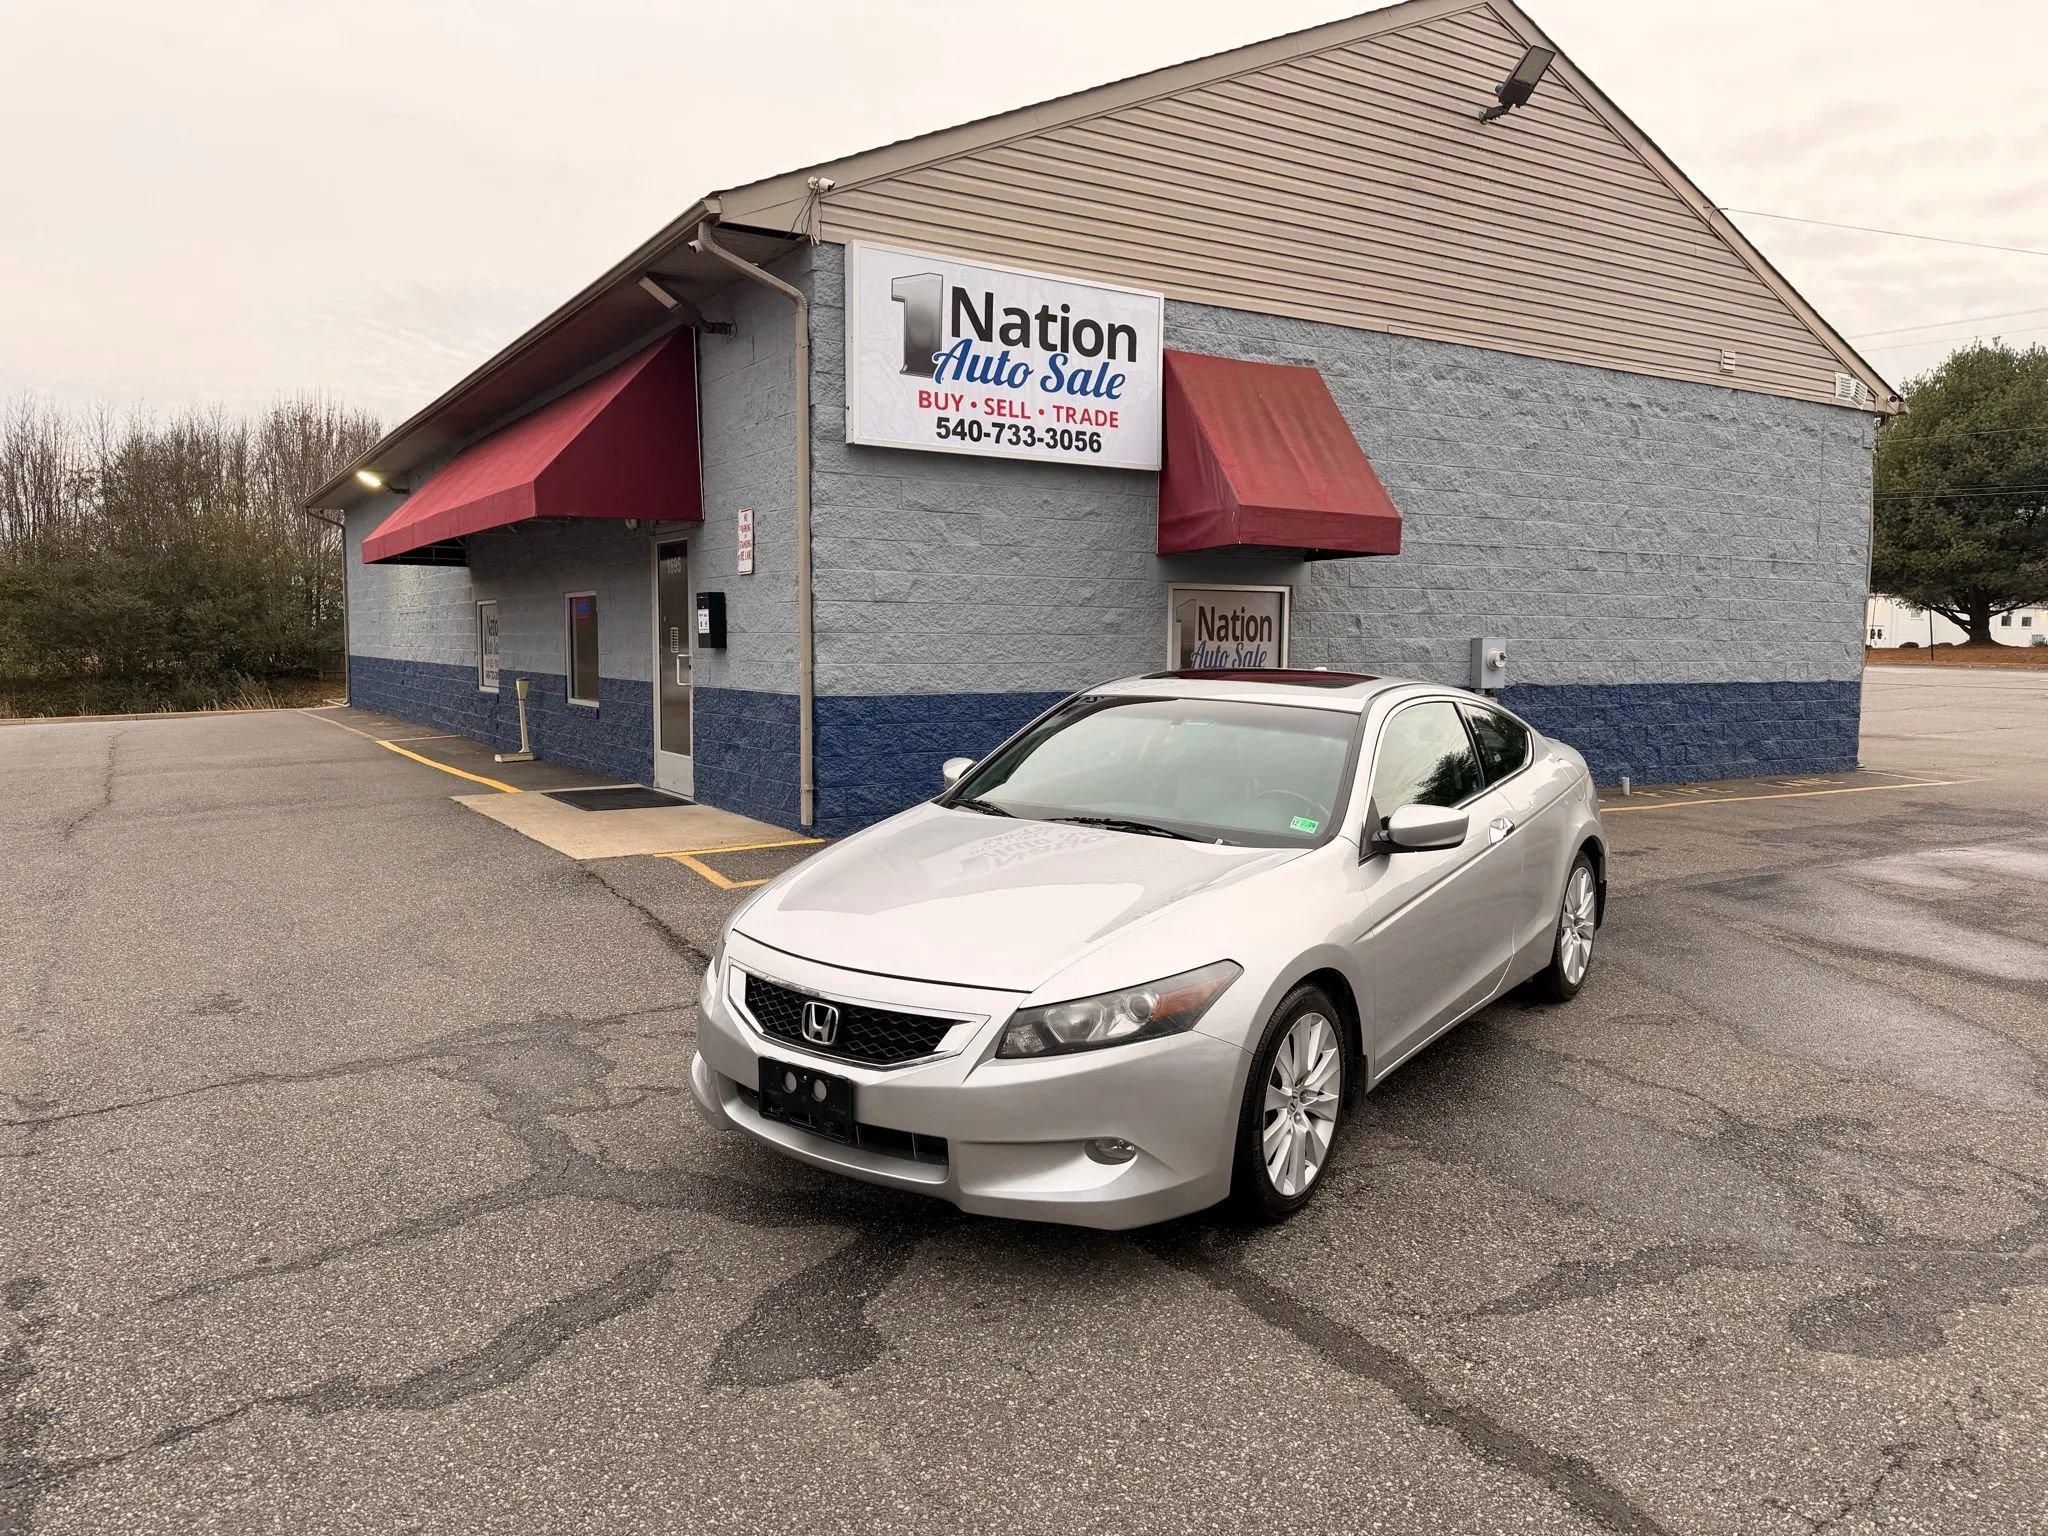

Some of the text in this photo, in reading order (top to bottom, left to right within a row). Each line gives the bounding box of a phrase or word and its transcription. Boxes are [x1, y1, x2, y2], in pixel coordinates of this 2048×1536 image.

[951, 286, 1138, 363] Nation
[932, 338, 1126, 400] Auto Sale
[918, 390, 1119, 428] BUY SELL TRADE
[936, 417, 1102, 453] 540-733-3056
[1198, 606, 1272, 642] Nation
[1191, 640, 1267, 669] Auto Sale
